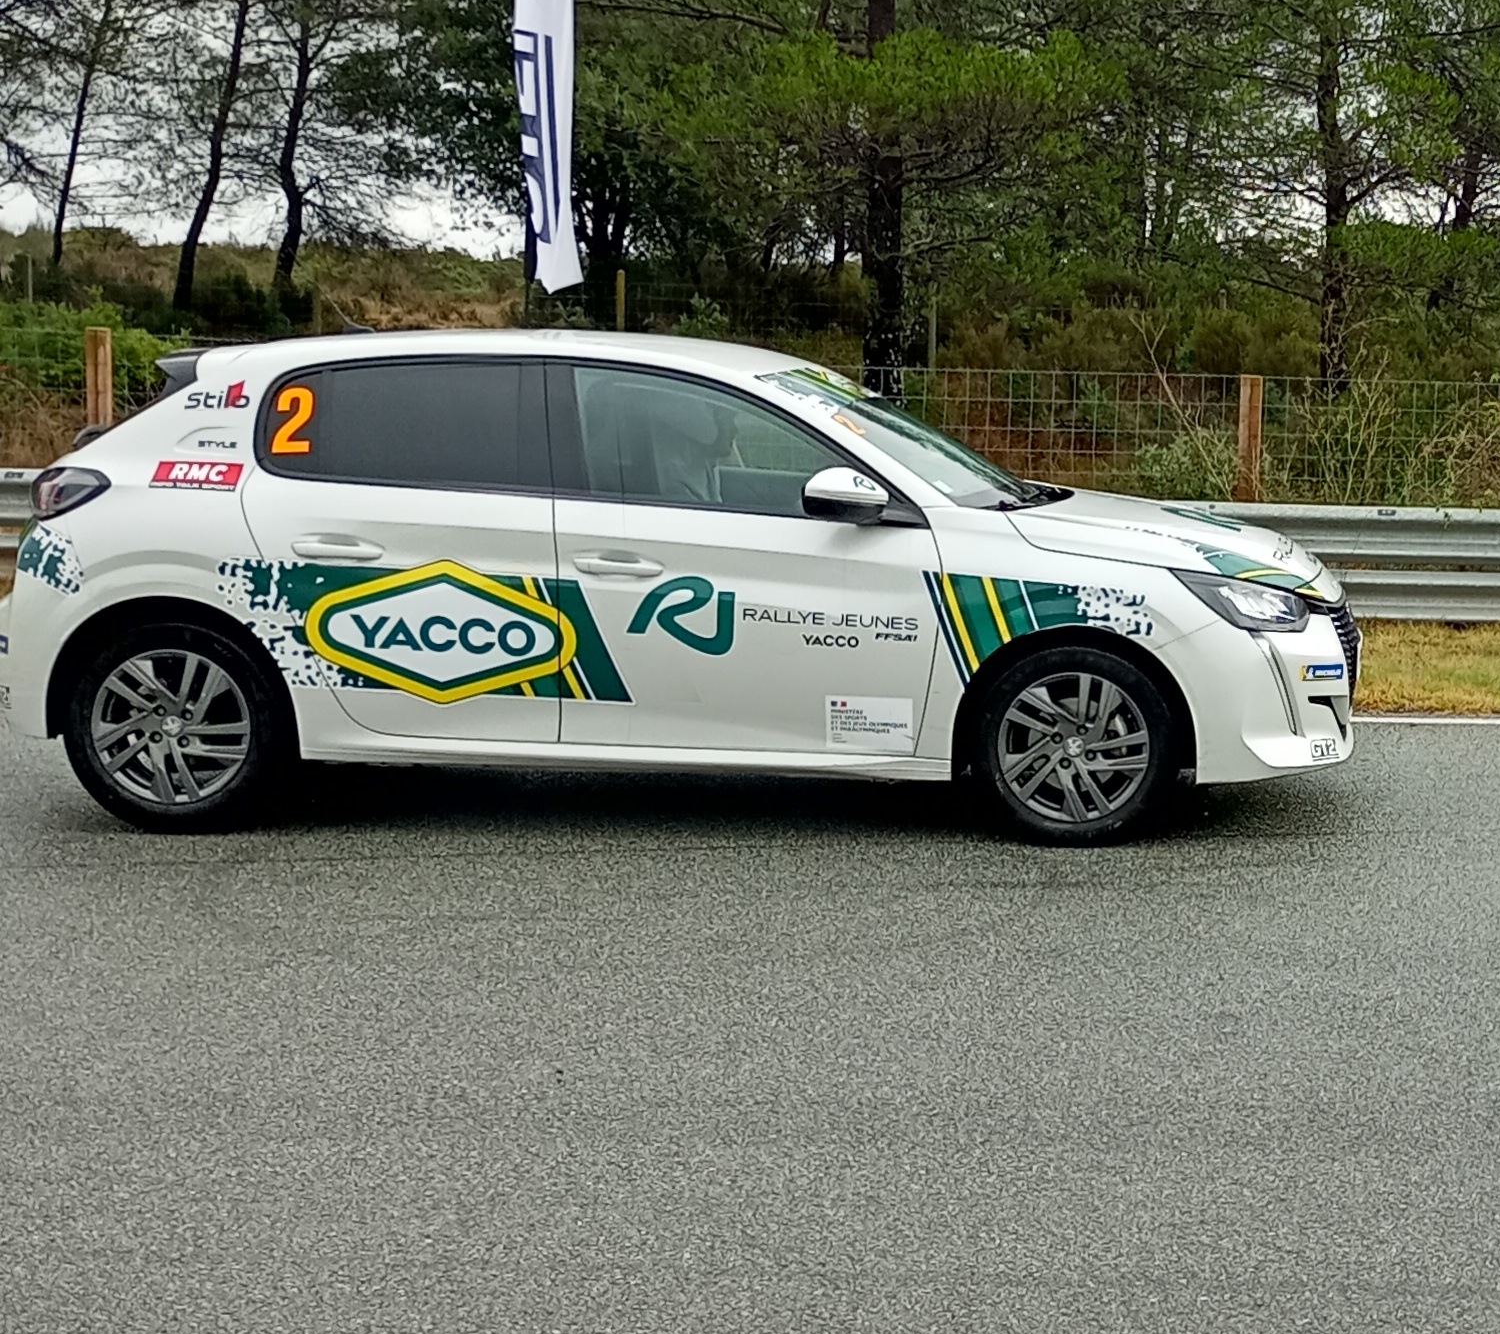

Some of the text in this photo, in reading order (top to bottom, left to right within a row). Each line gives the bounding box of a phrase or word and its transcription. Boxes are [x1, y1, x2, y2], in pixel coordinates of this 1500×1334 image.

[184, 380, 251, 410] Stilo
[271, 385, 315, 456] 2
[197, 440, 238, 449] STYLE
[168, 463, 229, 482] RMC
[742, 608, 919, 631] RALLYE JEUNES
[349, 613, 537, 656] YACCO
[802, 634, 860, 648] YACCO
